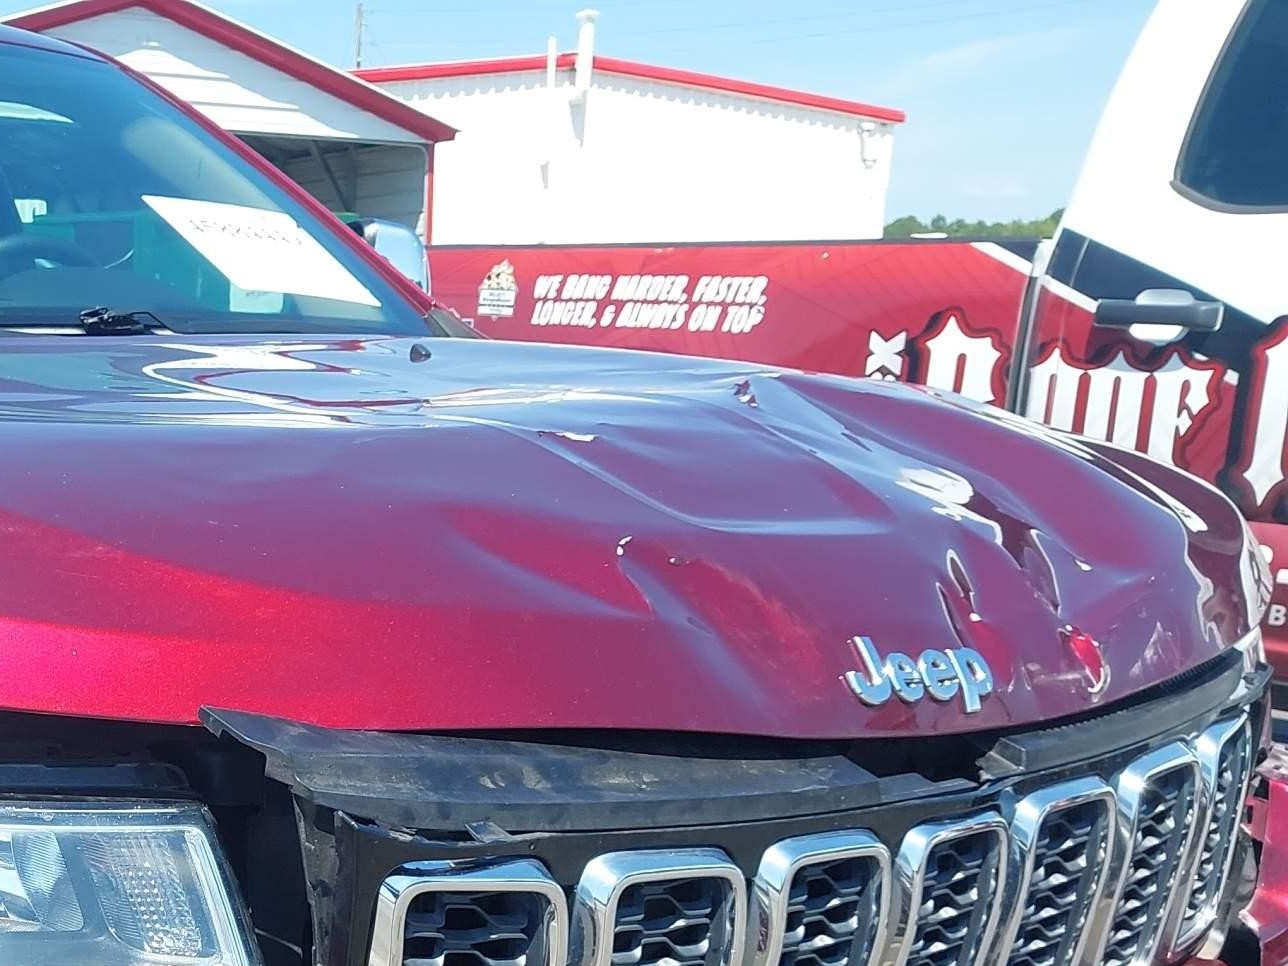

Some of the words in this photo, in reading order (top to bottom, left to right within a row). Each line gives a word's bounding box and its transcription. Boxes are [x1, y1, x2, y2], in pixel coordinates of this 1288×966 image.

[534, 275, 564, 300] WE
[562, 274, 613, 301] BANG
[611, 275, 689, 304] HARDER,
[692, 276, 769, 306] FASTER,
[531, 301, 598, 328] LONGER,
[615, 302, 690, 330] ALWAYS
[688, 304, 723, 332] ON
[721, 305, 766, 335] TOP
[845, 636, 994, 714] Jeep
